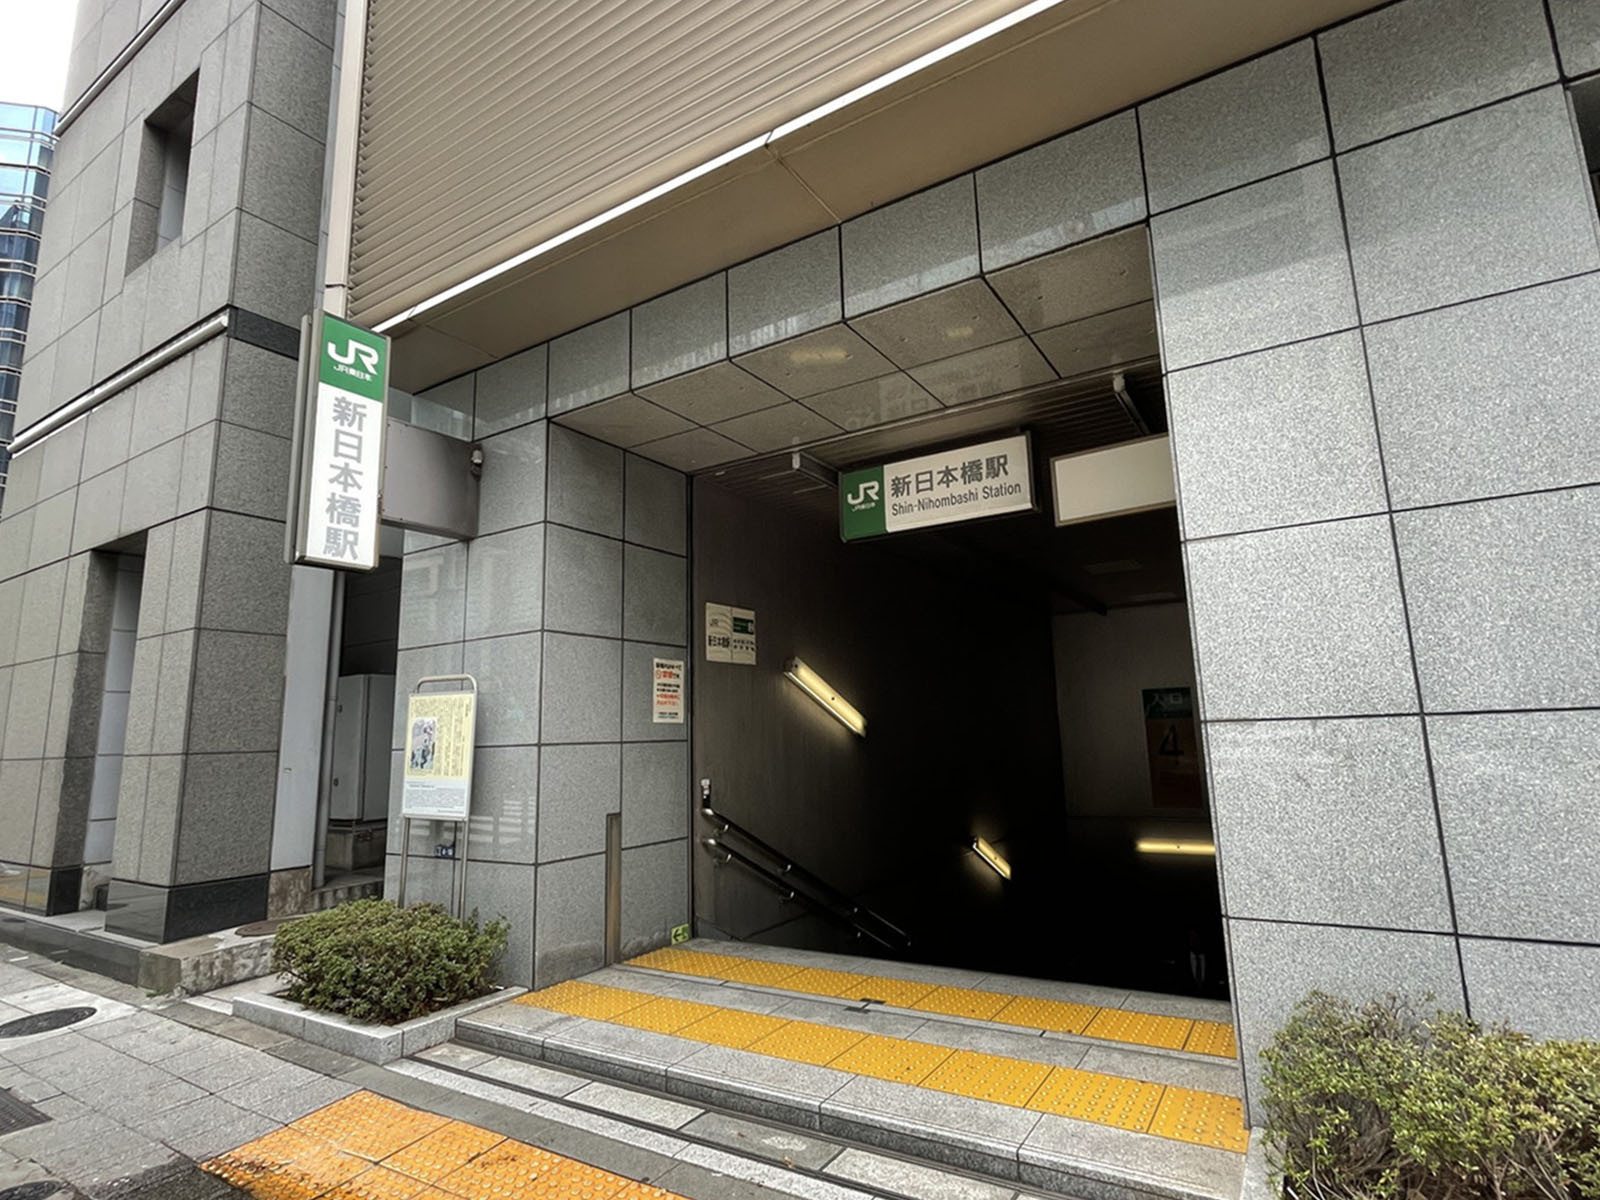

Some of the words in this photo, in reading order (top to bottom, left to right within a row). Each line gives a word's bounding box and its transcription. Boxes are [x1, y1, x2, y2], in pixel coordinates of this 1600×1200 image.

[327, 339, 379, 376] JR
[323, 396, 367, 560] 新日本橋駅
[847, 480, 879, 505] JR
[891, 454, 1009, 498] 新日本橋駅
[891, 488, 979, 516] Shin-Nihombashi
[982, 482, 1022, 500] Station
[1159, 724, 1185, 766] 4
